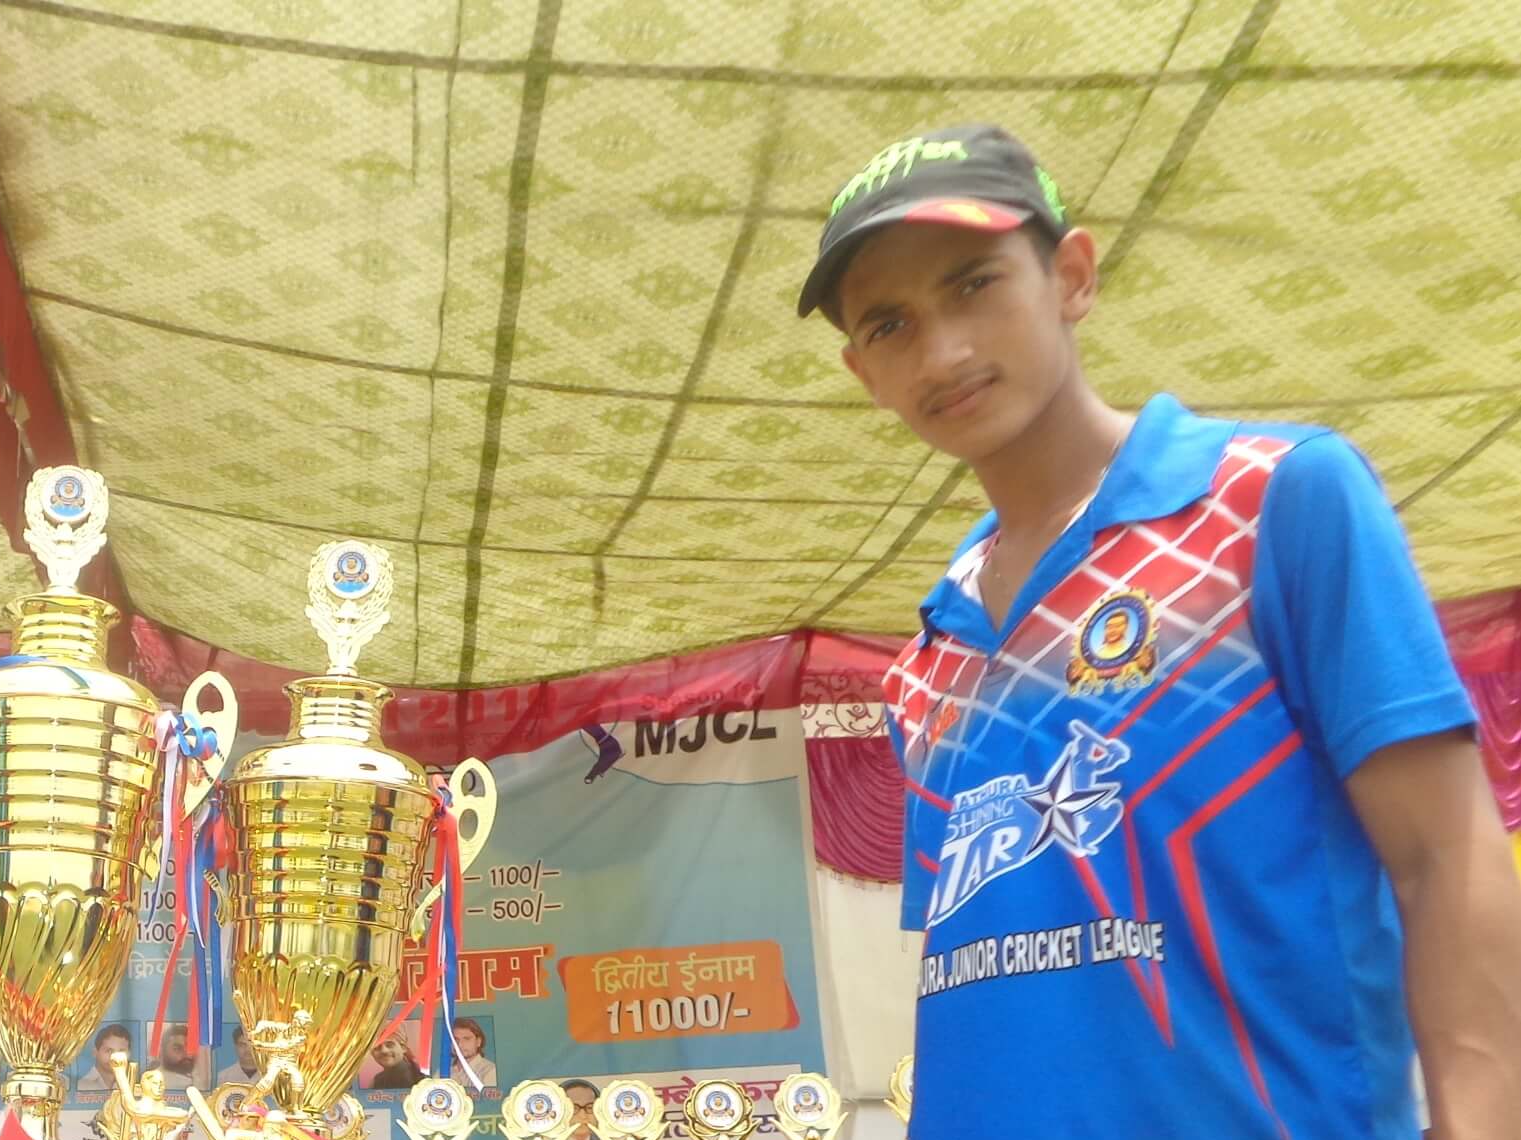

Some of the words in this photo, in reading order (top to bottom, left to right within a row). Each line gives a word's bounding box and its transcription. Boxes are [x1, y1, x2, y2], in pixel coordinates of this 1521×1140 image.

[634, 700, 778, 758] MJCL
[490, 859, 560, 889] 1100/-
[928, 826, 1021, 921] TAR
[492, 892, 562, 923] 500/-
[1001, 923, 1083, 976] CRICKET
[1089, 916, 1165, 964] LEAGUE
[591, 954, 670, 994] द्वितीय
[677, 952, 756, 992] ईनाम
[606, 991, 751, 1036] 11000/-
